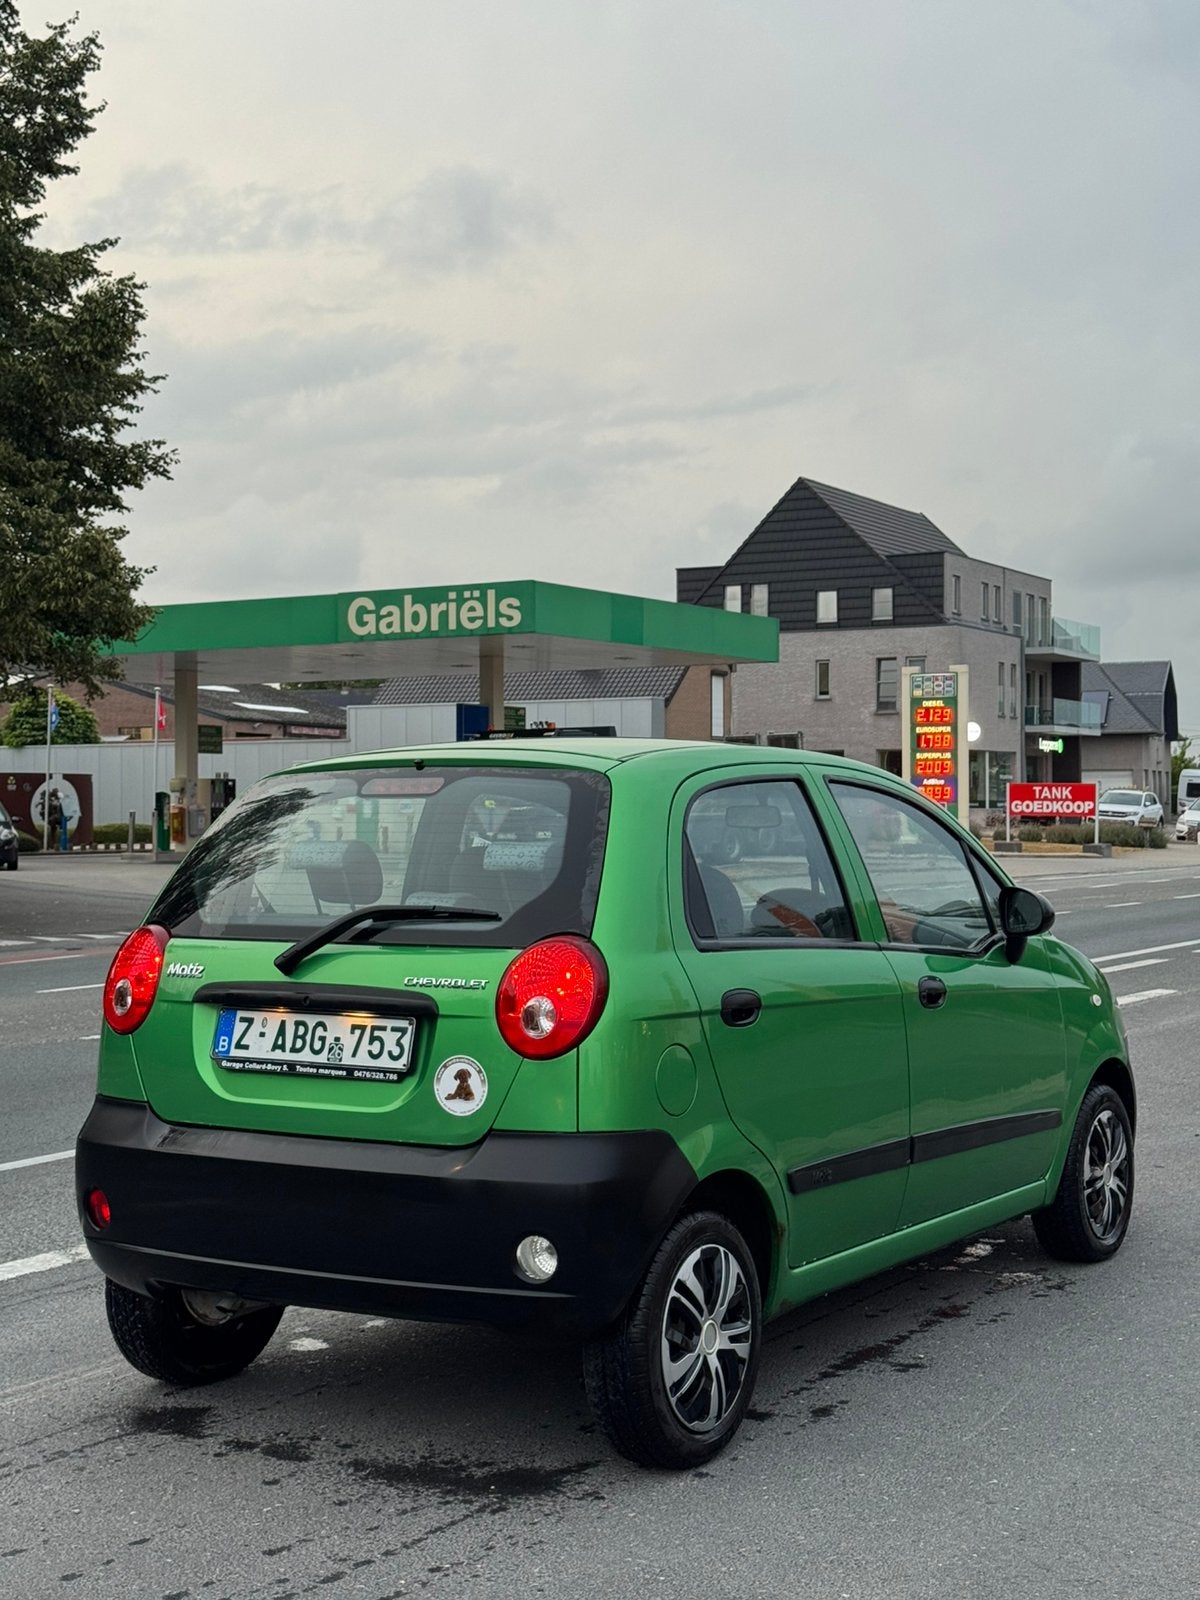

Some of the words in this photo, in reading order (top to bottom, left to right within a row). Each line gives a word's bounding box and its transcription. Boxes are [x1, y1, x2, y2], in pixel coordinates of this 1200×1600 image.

[347, 589, 522, 636] Gabriëls
[915, 726, 951, 734] EUROSUPER
[915, 752, 951, 760] SUPERPLUS
[1032, 786, 1073, 800] TANK
[1010, 800, 1095, 814] GOEDKOOP
[166, 962, 206, 979] Matiz
[404, 976, 489, 990] CHEVROLET
[218, 1036, 229, 1052] B
[327, 1043, 344, 1059] 26
[221, 1060, 243, 1069] Garage
[295, 1065, 317, 1073] Toutes
[318, 1068, 347, 1077] marques
